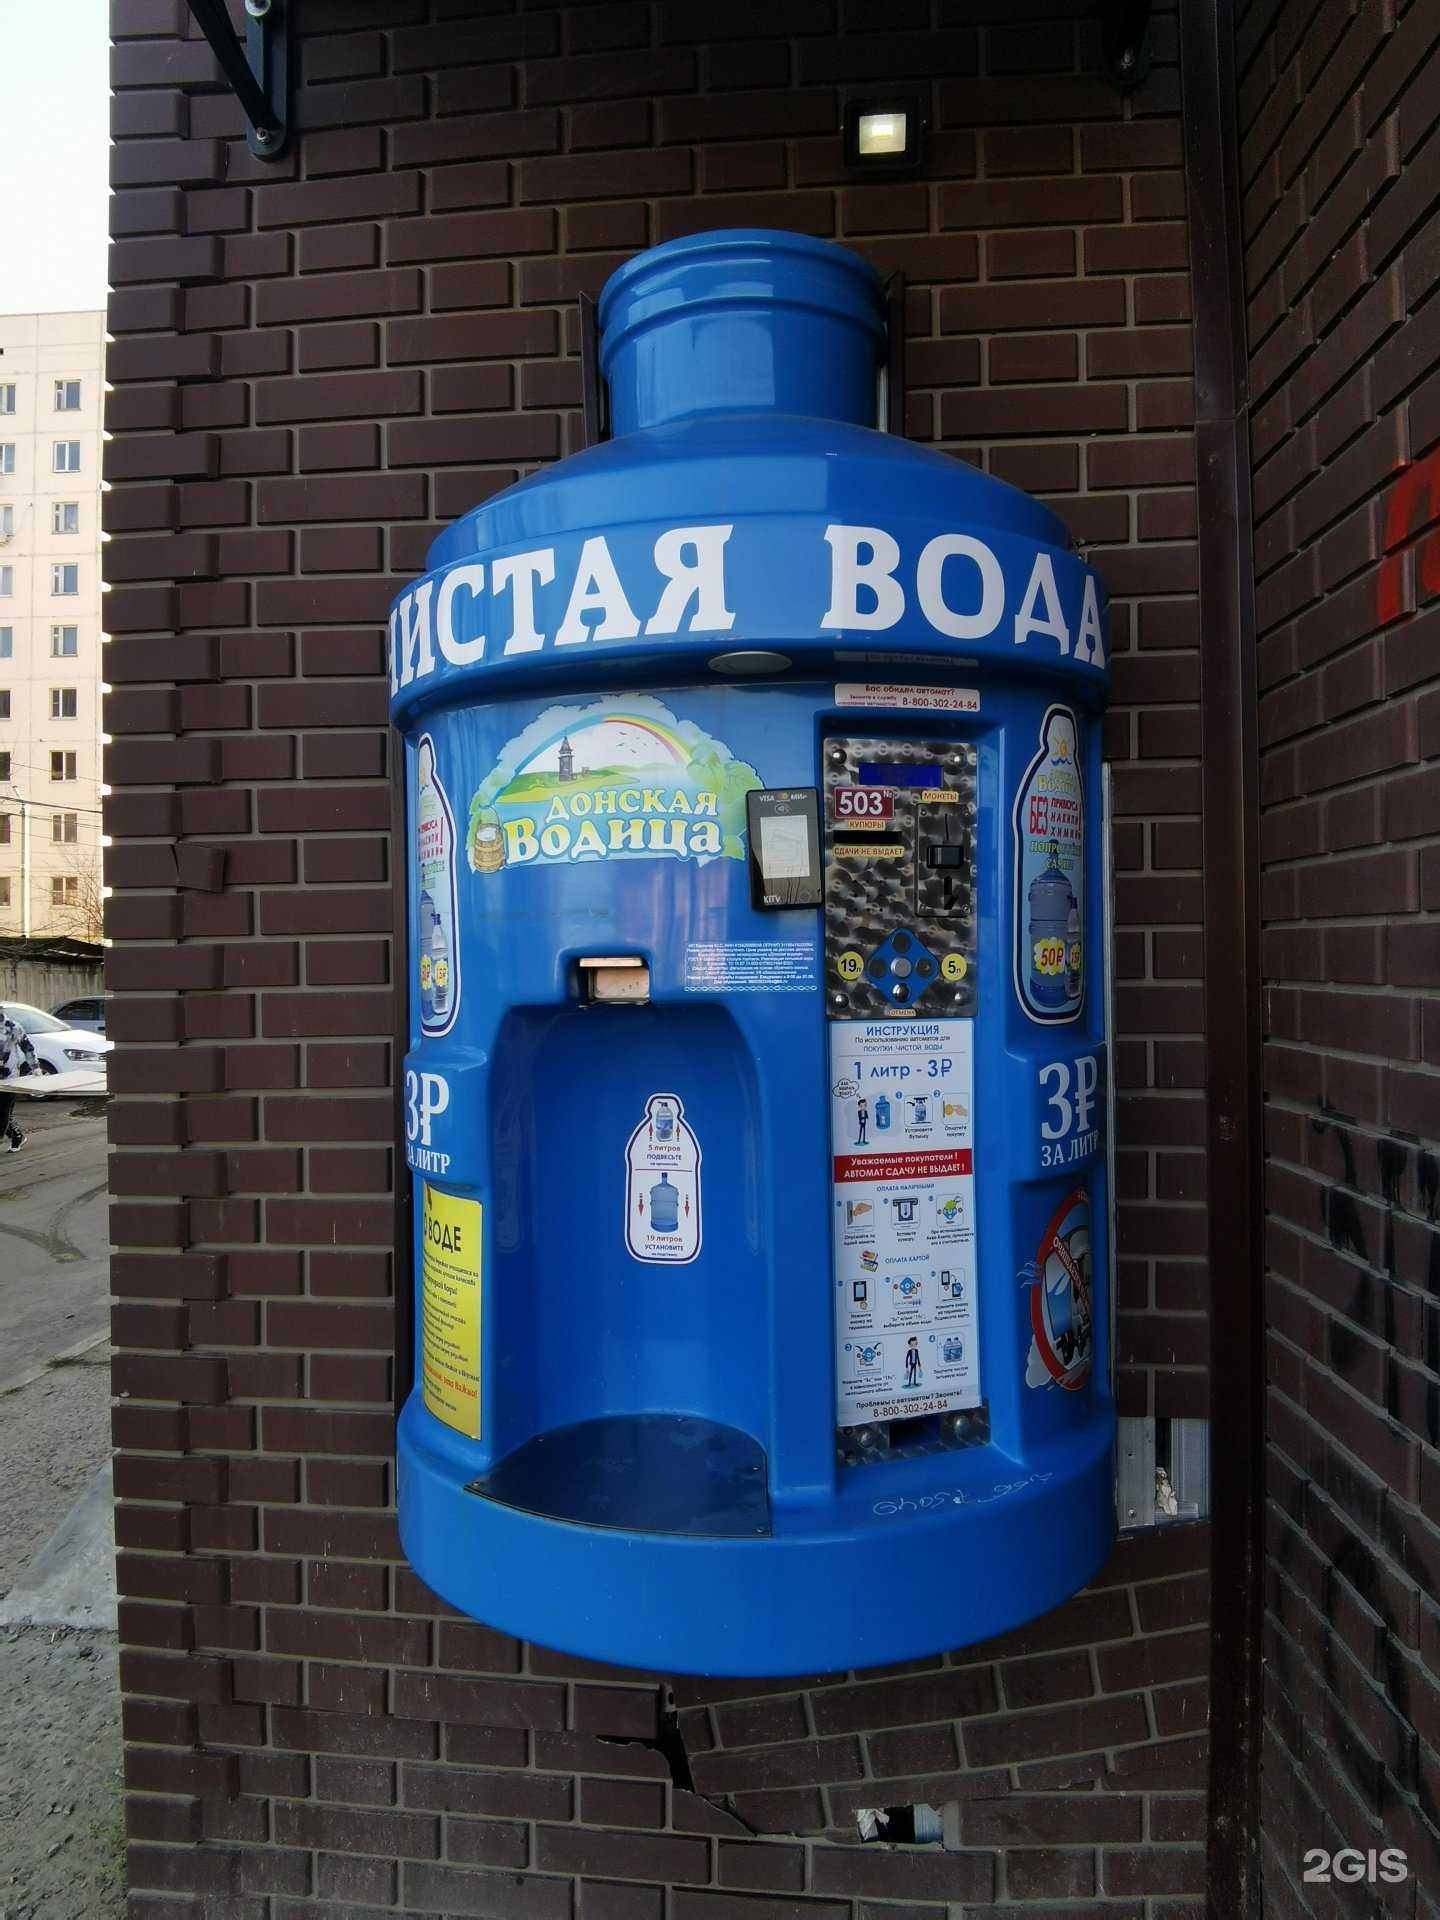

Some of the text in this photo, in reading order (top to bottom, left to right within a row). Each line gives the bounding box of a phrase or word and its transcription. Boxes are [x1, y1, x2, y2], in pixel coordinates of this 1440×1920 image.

[820, 524, 1105, 670] ВОДА
[902, 697, 977, 710] 8-800-302-24-84
[838, 791, 884, 815] 503
[923, 792, 957, 801] МОНЕТЫ
[546, 788, 718, 823] ДОНСКАЯ
[1029, 796, 1049, 836] БЕЗ
[848, 821, 885, 830] КУПЮРЫ
[504, 818, 722, 864] Водица
[834, 847, 903, 856] СДАЧИ НЕ ВЫДАЕТ
[866, 1024, 940, 1037] ИНСТРУКЦИЯ
[855, 1036, 864, 1044] По
[863, 1043, 943, 1053] ПОКУПКИ ЧИСТОЙ ВОДЫ
[853, 1061, 862, 1081] 1
[870, 1065, 911, 1081] литр
[653, 1145, 681, 1154] литров
[1041, 1129, 1099, 1167] ЗА ЛИТР
[415, 1148, 451, 1174] ЛИТР
[646, 1153, 682, 1161] ПОДВЕСЬТЕ
[851, 1156, 903, 1166] Уважаемые
[844, 1168, 884, 1178] АВТОМАТ
[885, 1166, 916, 1177] СДАЧУ
[917, 1165, 928, 1174] НЕ
[428, 1216, 462, 1254] ВОДЕ
[646, 1234, 683, 1244] 19 литров
[856, 1398, 891, 1410] Проблемы
[873, 1399, 948, 1418] 8-800-302-24-84
